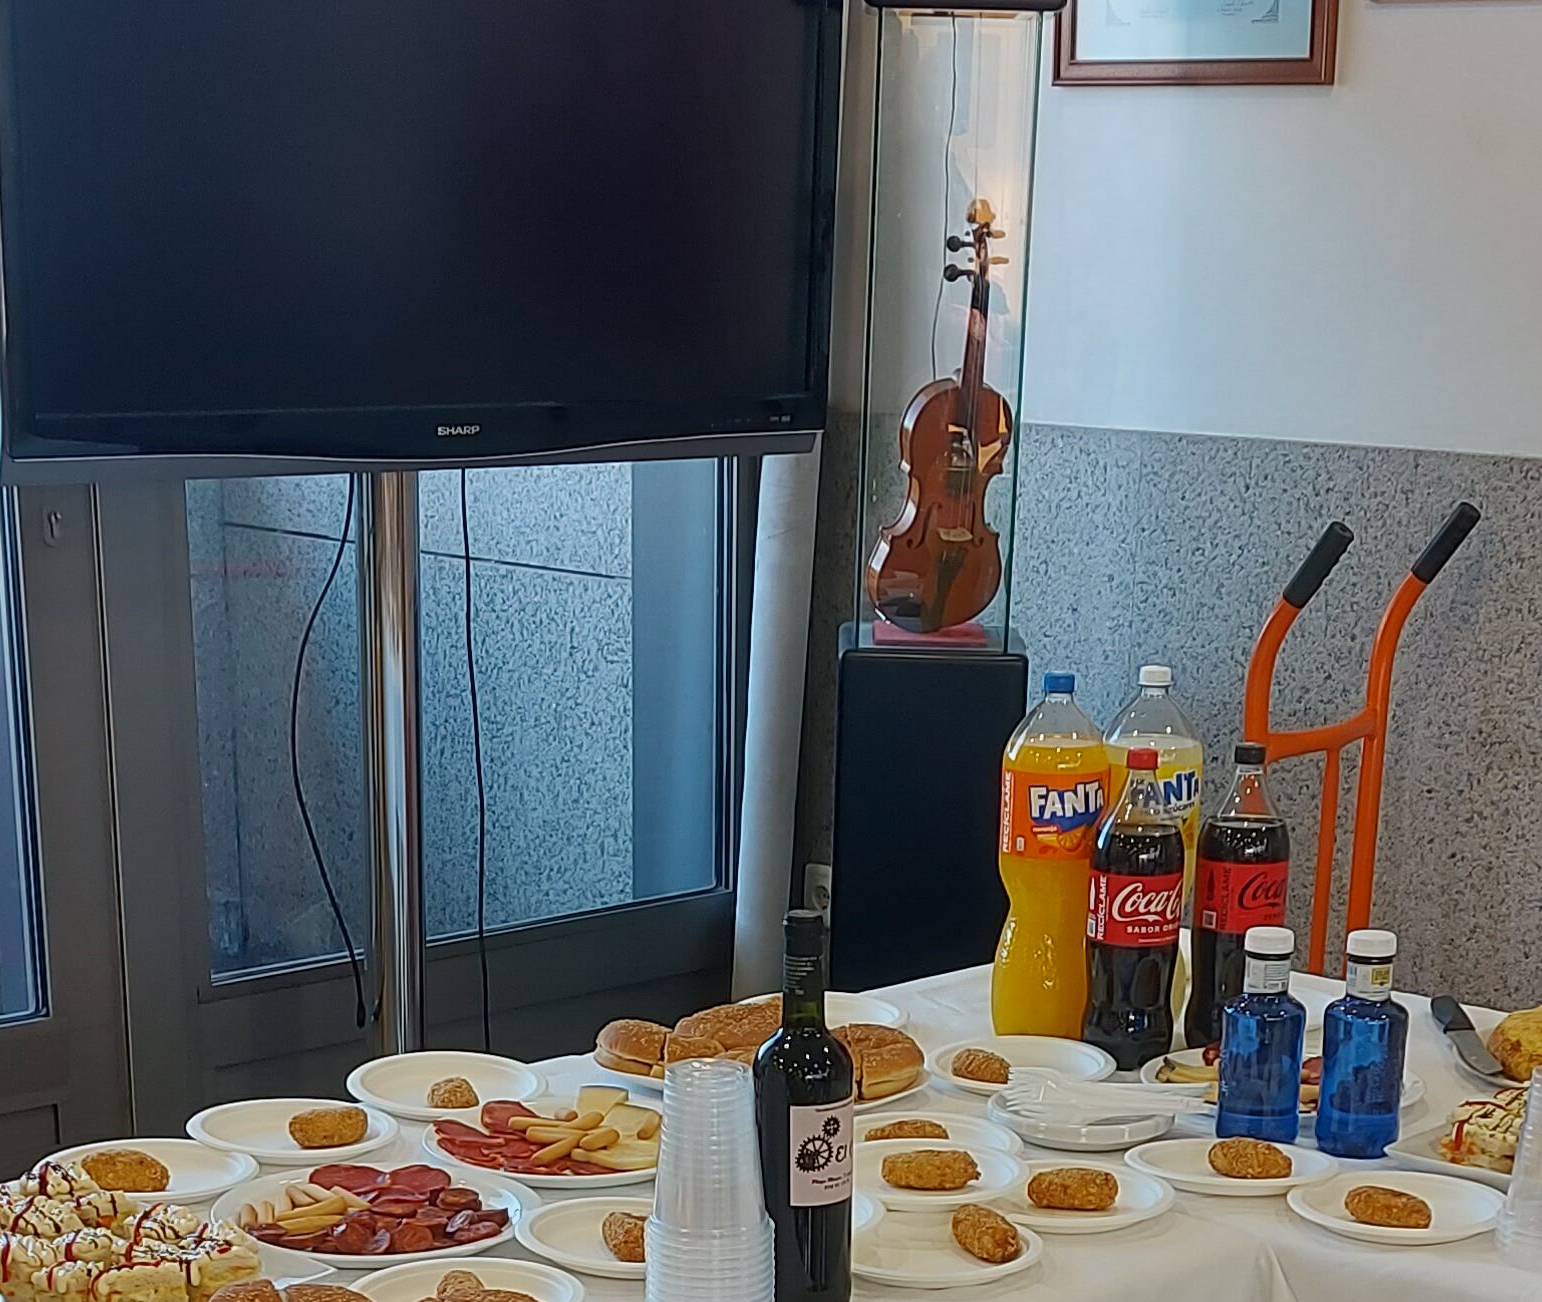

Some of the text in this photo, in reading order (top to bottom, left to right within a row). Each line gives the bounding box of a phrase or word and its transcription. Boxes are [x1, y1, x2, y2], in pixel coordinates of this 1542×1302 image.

[437, 425, 480, 436] SHARP
[1030, 781, 1104, 820] FANTA
[1126, 925, 1160, 934] SABOR
